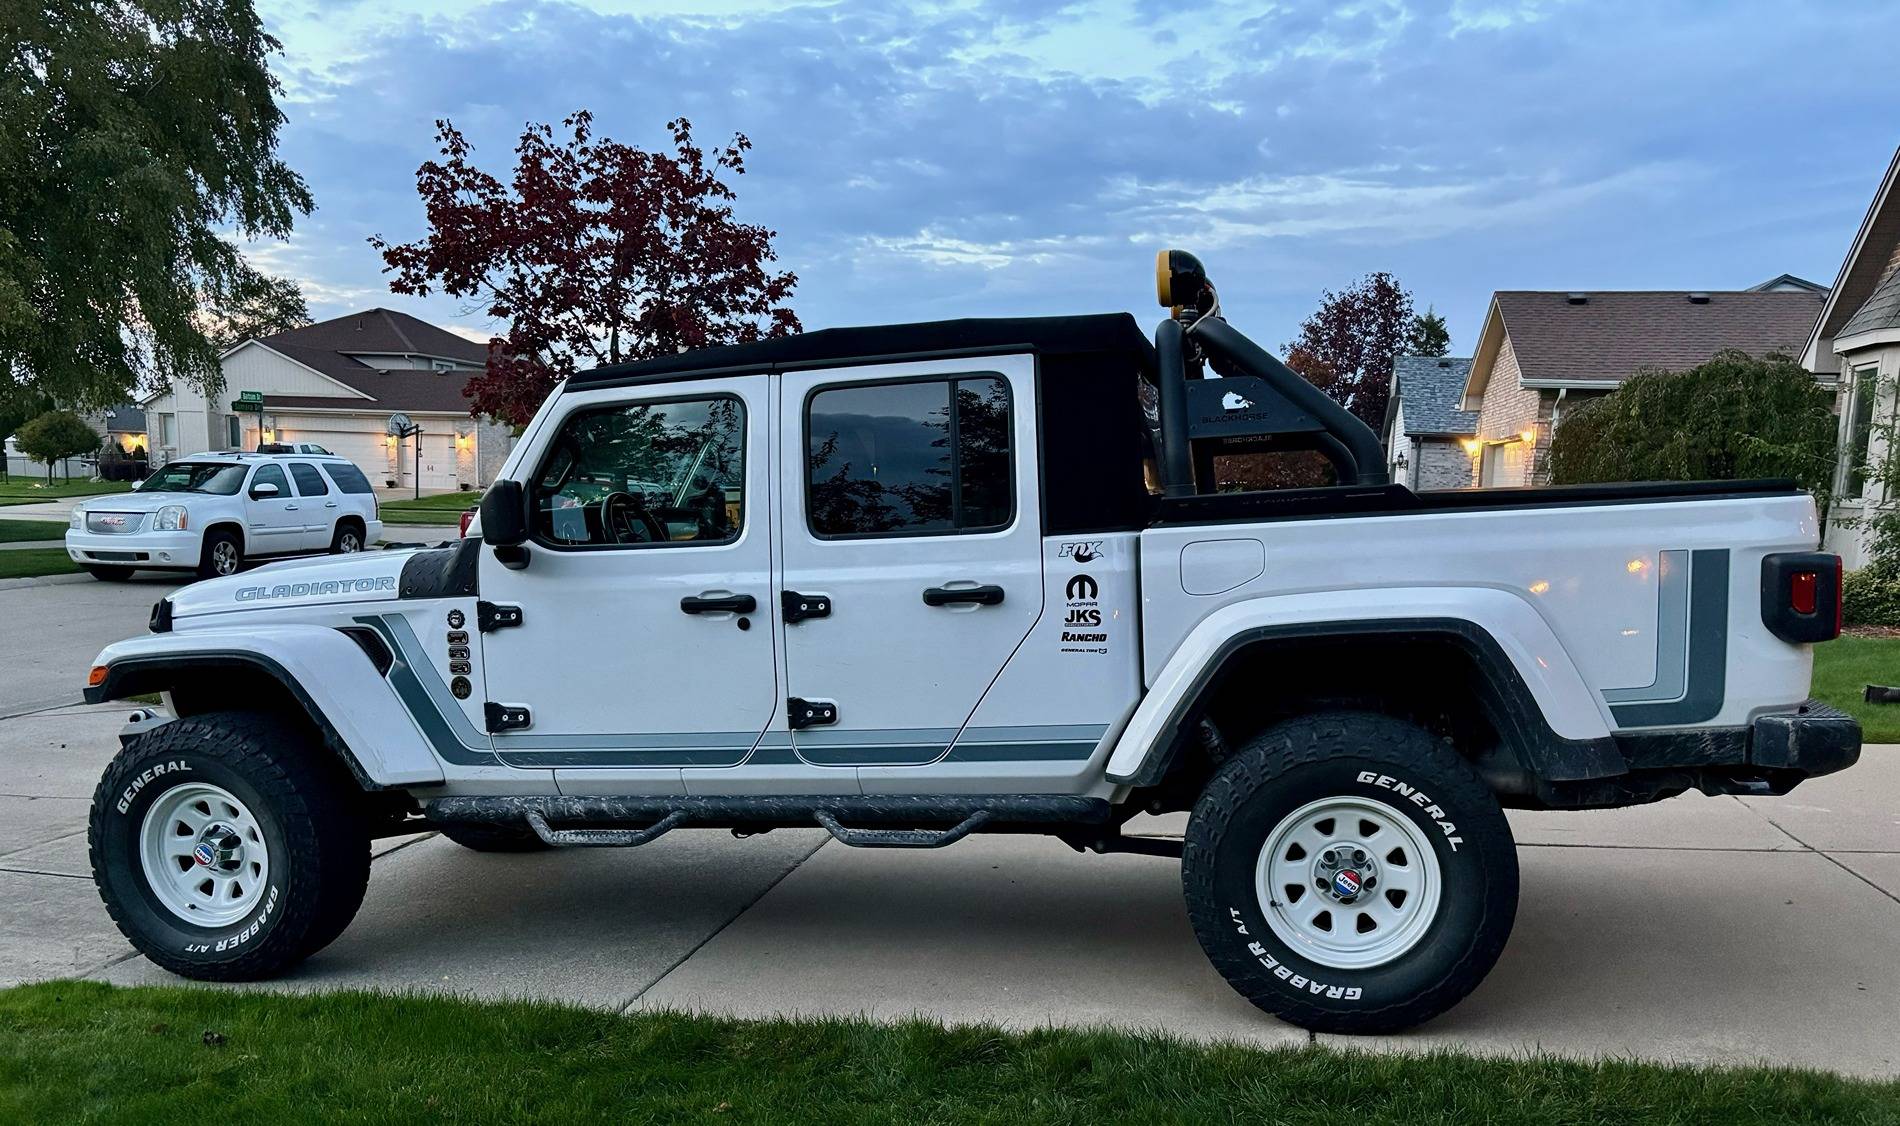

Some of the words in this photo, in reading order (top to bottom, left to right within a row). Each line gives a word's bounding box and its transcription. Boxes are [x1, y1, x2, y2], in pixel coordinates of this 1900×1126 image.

[1202, 412, 1268, 424] BLACKHORSE
[1058, 541, 1104, 563] FOX
[234, 576, 396, 601] GLADIATOR
[1064, 609, 1102, 627] JKS
[1061, 631, 1108, 642] RANCHO
[117, 760, 192, 815] GENERAL
[1356, 770, 1464, 853] GENERAL
[1338, 876, 1357, 891] Jeep
[215, 884, 279, 952] GRABBER
[1229, 906, 1249, 936] A/T
[184, 943, 210, 953] A/T
[1247, 940, 1364, 1000] GRABBER
